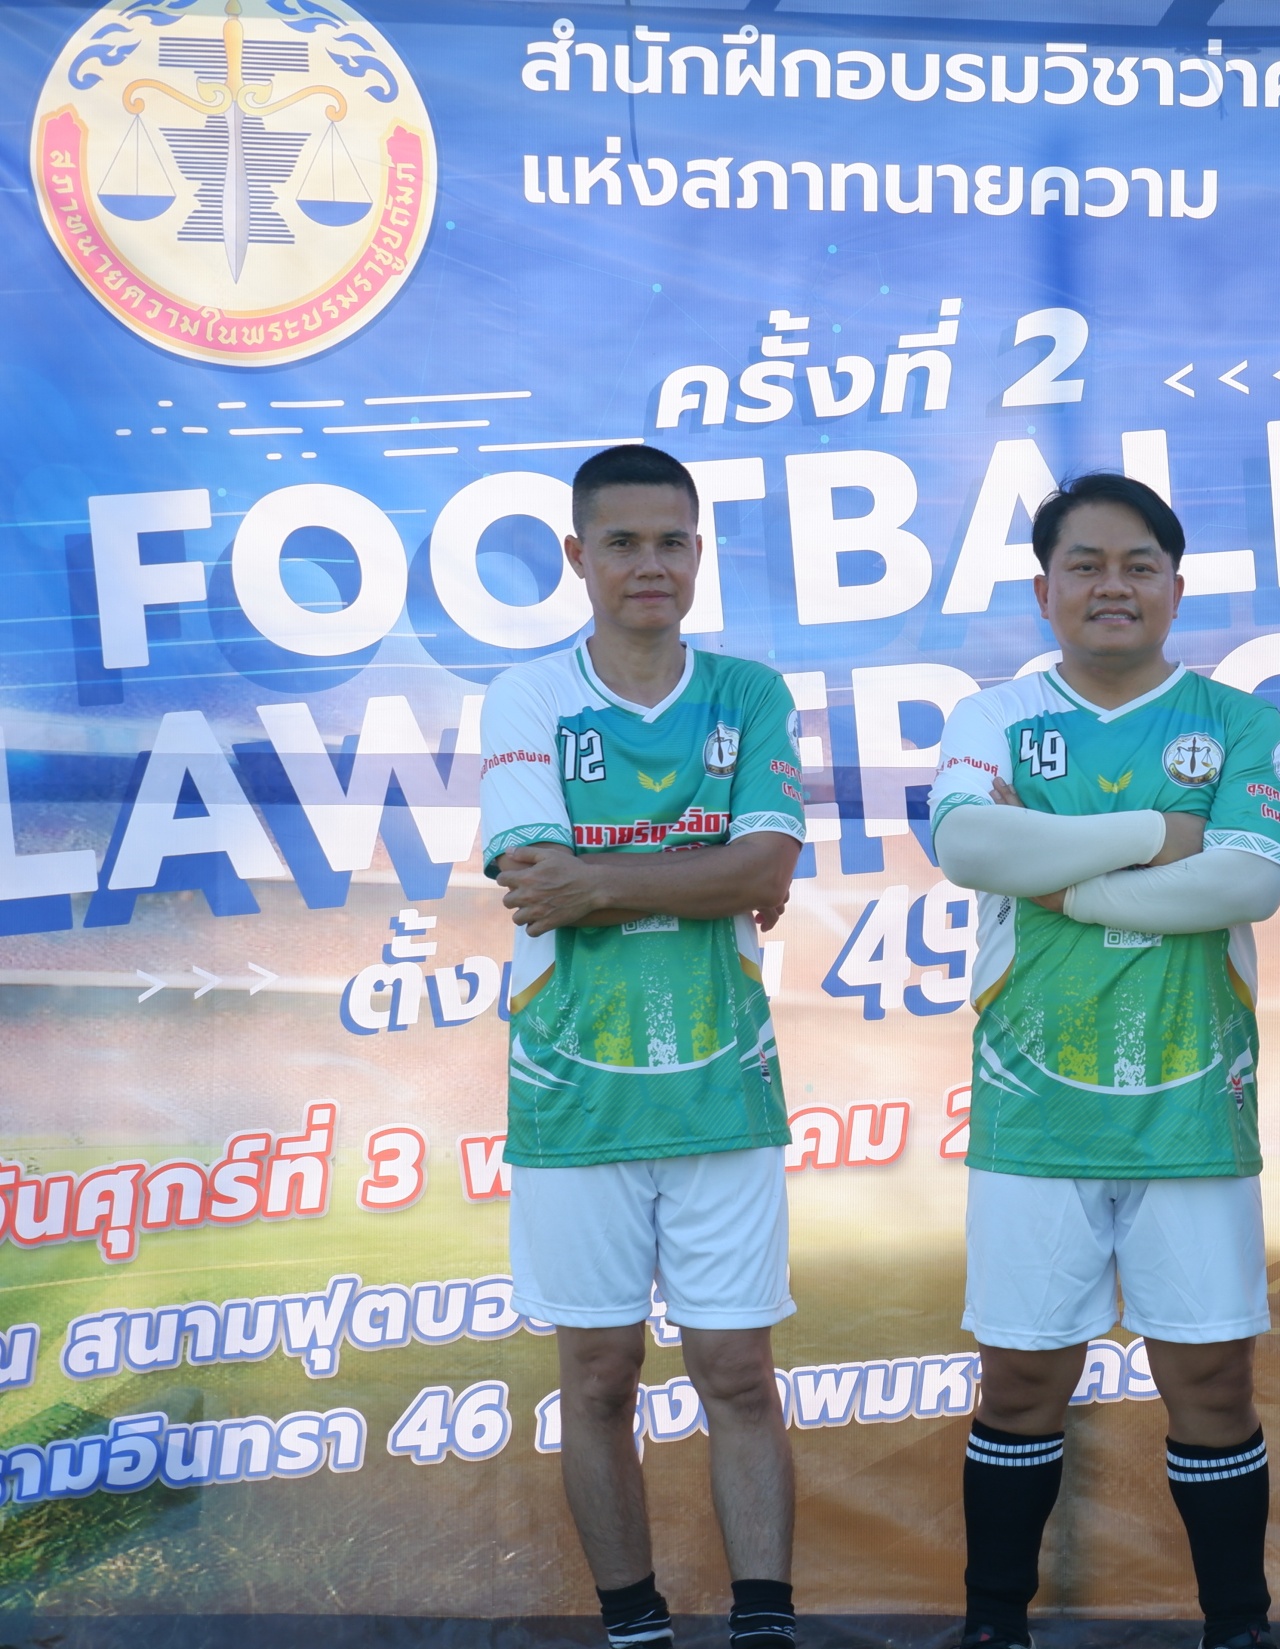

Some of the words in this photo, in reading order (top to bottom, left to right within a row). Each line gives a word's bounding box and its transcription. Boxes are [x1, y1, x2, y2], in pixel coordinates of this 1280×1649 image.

[523, 136, 1218, 219] แห่งสภาทนายความ
[655, 298, 962, 429] ครั้งที่
[1001, 307, 1090, 408] 2
[560, 726, 607, 784] 12
[1019, 728, 1068, 782] 49
[361, 1127, 427, 1210] 3
[0, 1411, 365, 1499] ามอินทรา
[389, 1383, 510, 1463] 46
